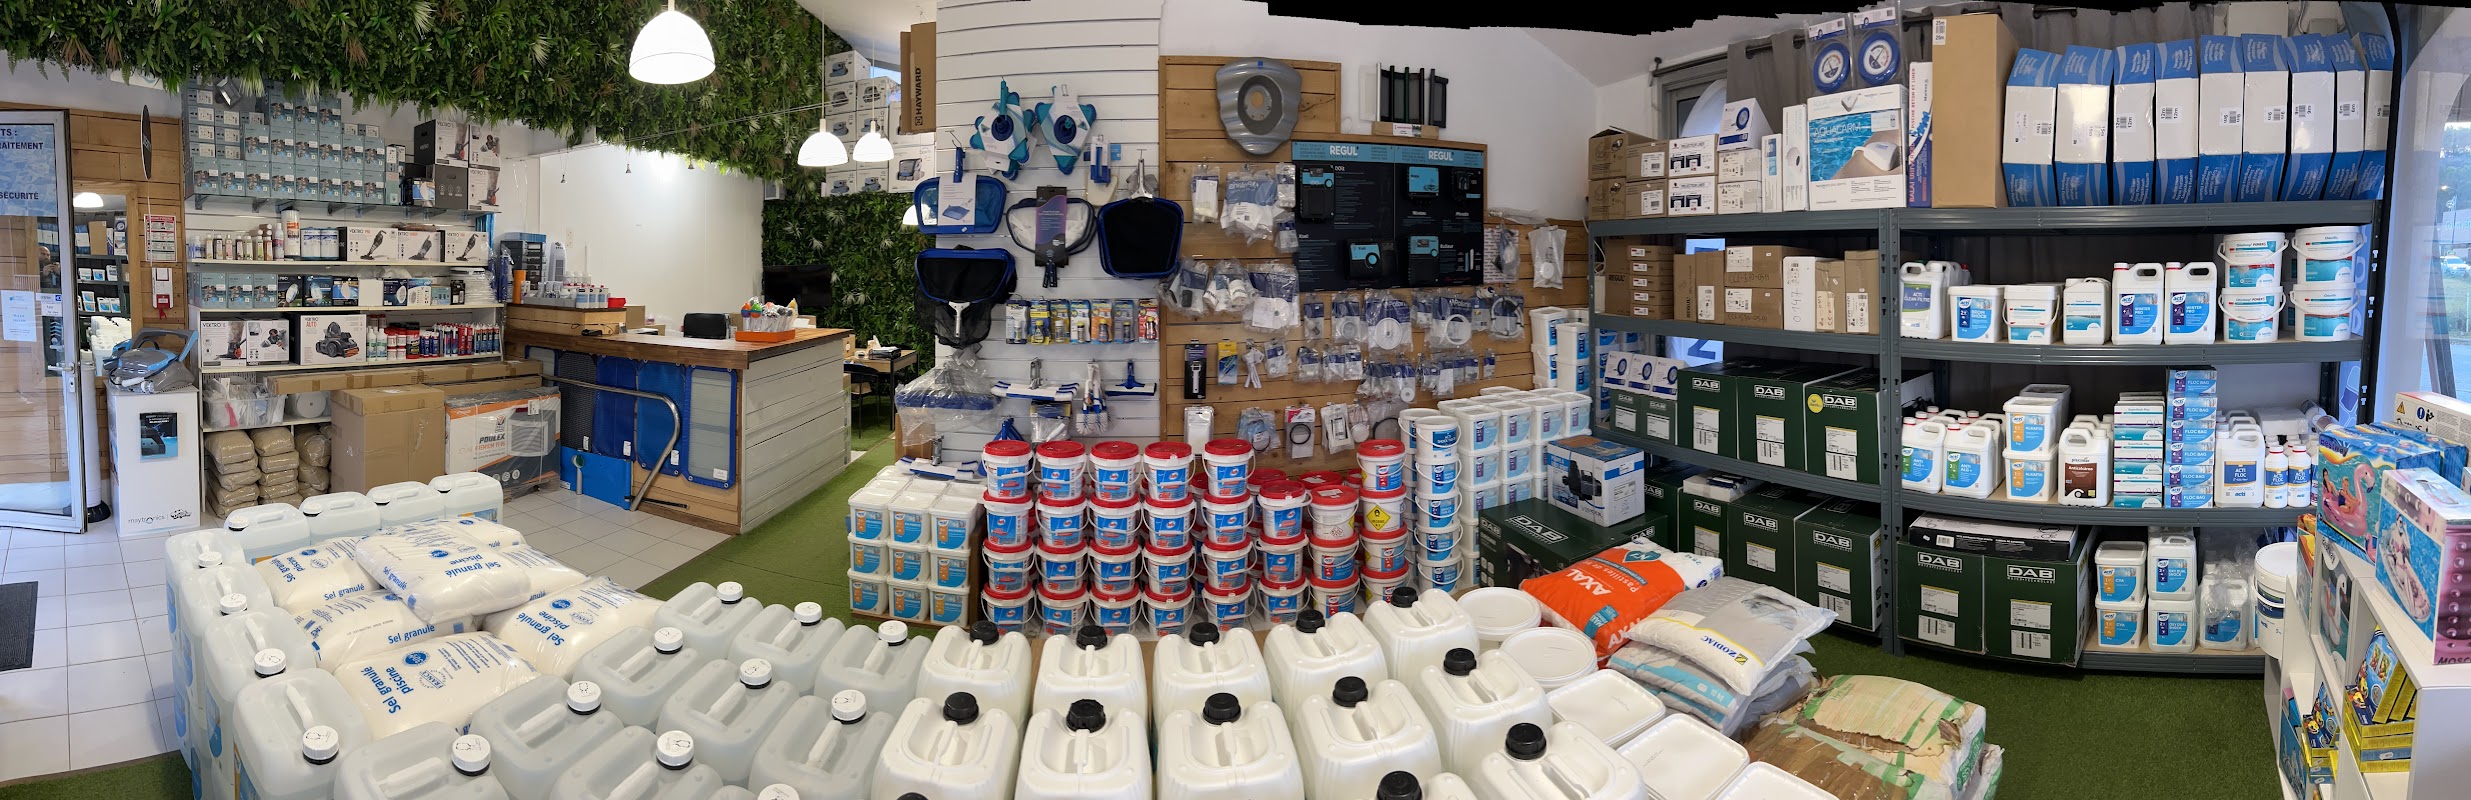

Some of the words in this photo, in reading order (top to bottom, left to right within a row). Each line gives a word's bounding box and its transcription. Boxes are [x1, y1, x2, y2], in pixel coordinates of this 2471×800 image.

[1693, 379, 1720, 389] DAB
[1755, 386, 1784, 396] DAB
[1825, 396, 1856, 406] DAB
[479, 433, 505, 444] POOLEX
[1695, 501, 1720, 514] DAB
[128, 515, 165, 527] maytronics
[1481, 520, 1500, 536] DAB
[1745, 514, 1777, 528] DAB
[1512, 516, 1563, 541] DAB
[1814, 531, 1851, 547] DAB
[449, 553, 483, 565] piscine
[486, 561, 501, 570] Sel
[1919, 554, 1961, 568] DAB
[445, 563, 483, 578] granulé
[2009, 567, 2053, 579] DAB
[1566, 569, 1612, 596] AXAL
[1605, 566, 1638, 593] Pastilles
[324, 591, 336, 601] Sel
[338, 583, 365, 597] granulé
[516, 613, 551, 634] granulé
[539, 611, 569, 630] piscine
[388, 633, 401, 644] Sel
[547, 633, 565, 646] Sel
[1701, 635, 1737, 658] ZODIAC
[361, 666, 392, 695] granulé
[386, 666, 414, 694] piscine
[382, 696, 401, 714] Sel
